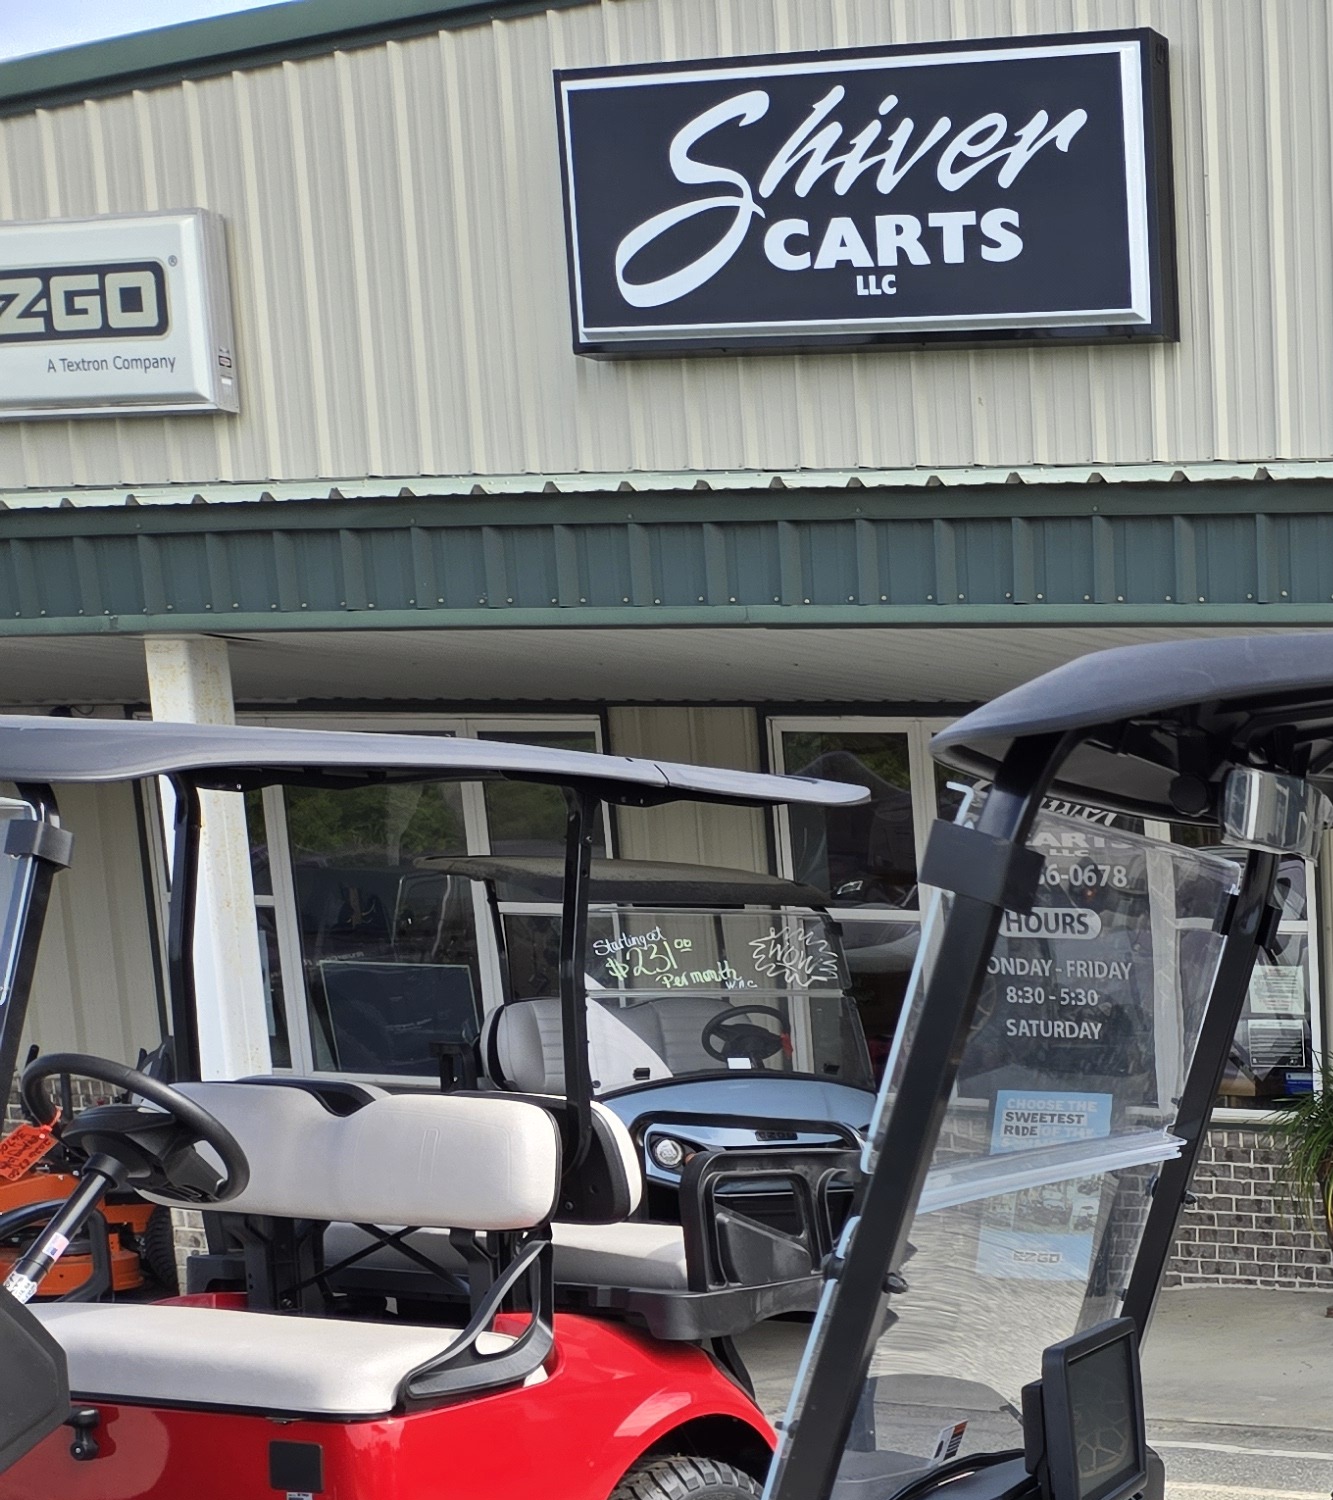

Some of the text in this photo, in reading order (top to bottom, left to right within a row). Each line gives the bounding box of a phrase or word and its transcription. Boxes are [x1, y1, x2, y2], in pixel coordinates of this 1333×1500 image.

[614, 84, 1089, 308] Shiver
[762, 209, 1024, 272] CARTS
[856, 273, 897, 296] LLC
[0, 270, 159, 335] ZGO
[47, 355, 176, 374] A Textron Company
[1004, 911, 1090, 935] HOURS
[987, 956, 1053, 977] ONDAY
[1066, 960, 1133, 980] FRIDAY
[1006, 985, 1045, 1004] 8:30
[1060, 988, 1099, 1007] 5:30
[1006, 1018, 1103, 1040] SATURDAY
[1006, 1098, 1099, 1113] CHOOSE THE
[1004, 1111, 1085, 1125] SWEETEST
